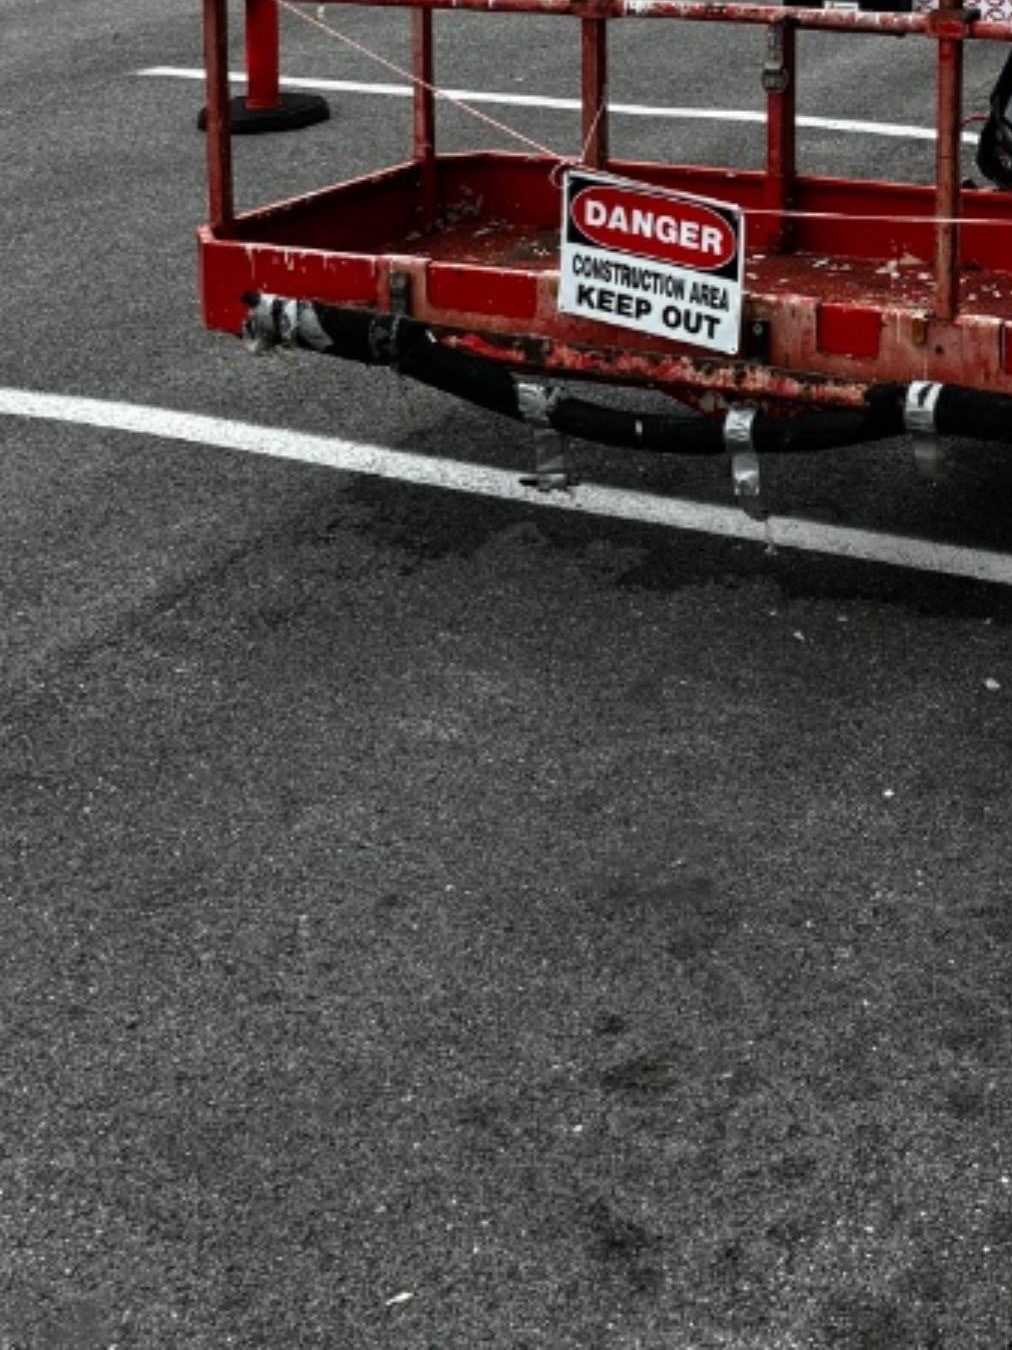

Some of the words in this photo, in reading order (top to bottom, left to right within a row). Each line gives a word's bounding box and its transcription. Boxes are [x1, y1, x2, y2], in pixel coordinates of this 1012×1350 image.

[584, 199, 724, 256] DANGER
[572, 252, 686, 301] CONSTRUCTION
[689, 281, 730, 313] AREA
[576, 284, 652, 320] KEEP
[662, 304, 721, 340] OUT
